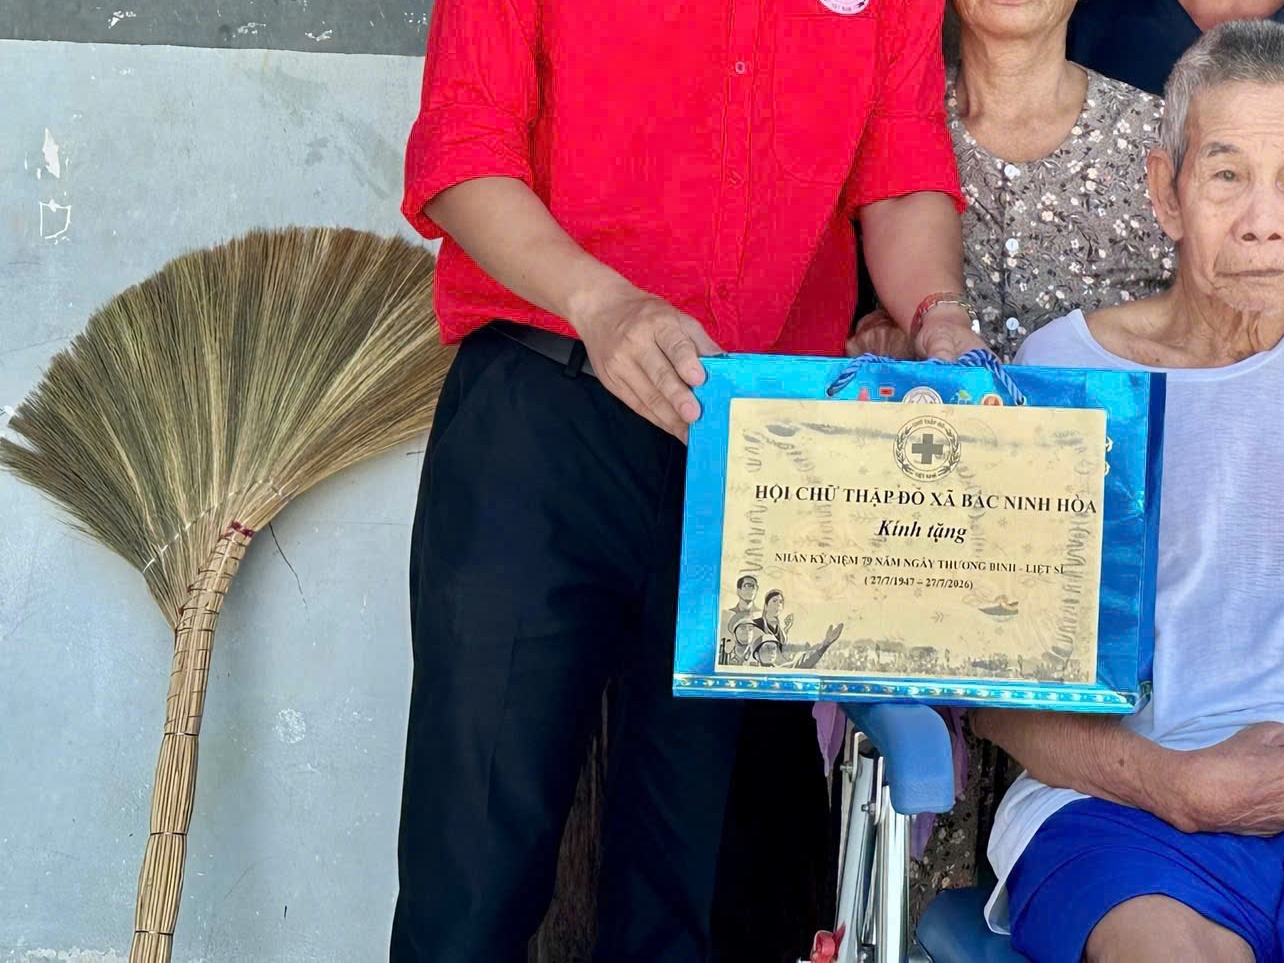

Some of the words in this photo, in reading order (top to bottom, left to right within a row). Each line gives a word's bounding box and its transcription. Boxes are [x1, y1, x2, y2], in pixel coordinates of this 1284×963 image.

[755, 484, 790, 504] HỘI
[795, 484, 840, 502] CHỮ
[843, 487, 895, 507] THẬP
[898, 486, 925, 506] ĐỎ
[930, 489, 956, 508] XÃ
[1004, 494, 1051, 512] NINH
[1057, 493, 1097, 514] HÒA
[874, 519, 922, 538] Kính
[926, 523, 968, 544] tặng
[862, 556, 873, 566] 79
[938, 559, 987, 571] THƯƠNG
